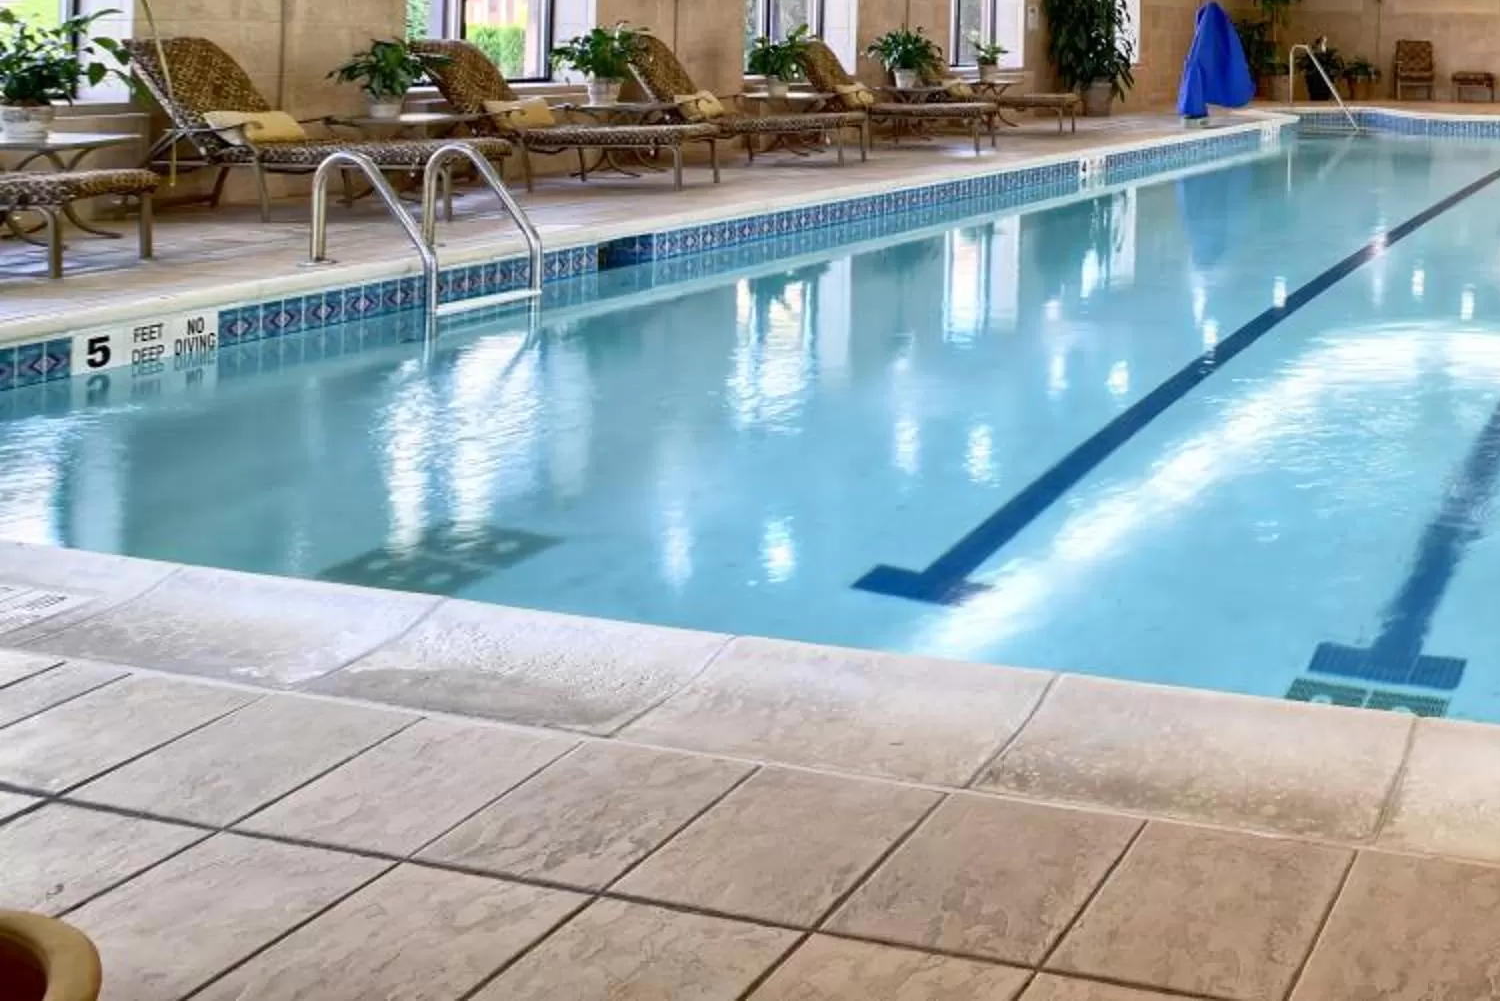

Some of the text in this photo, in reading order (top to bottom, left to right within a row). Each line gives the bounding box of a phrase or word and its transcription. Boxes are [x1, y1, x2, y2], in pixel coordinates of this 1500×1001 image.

[86, 316, 205, 368] 5 FEET NO
[131, 332, 216, 365] DEEP DIVING
